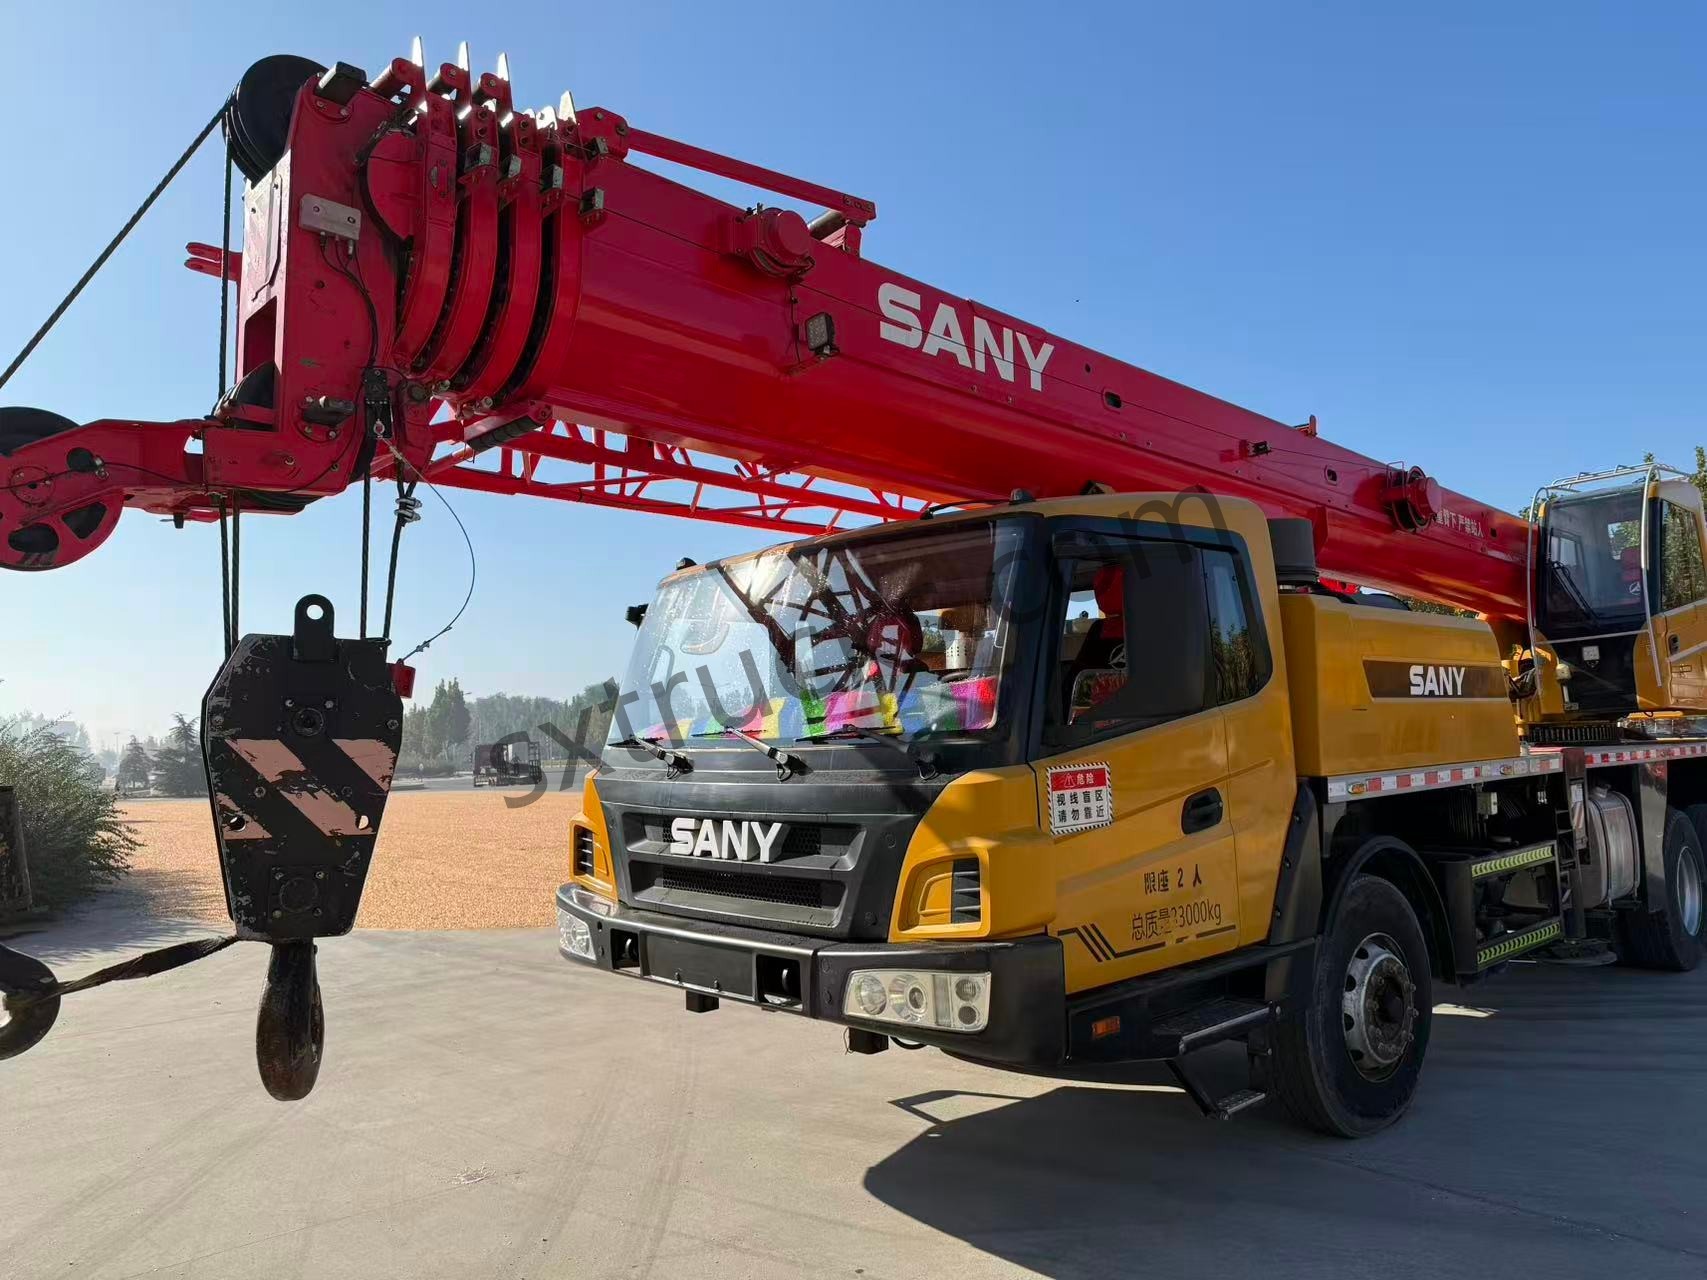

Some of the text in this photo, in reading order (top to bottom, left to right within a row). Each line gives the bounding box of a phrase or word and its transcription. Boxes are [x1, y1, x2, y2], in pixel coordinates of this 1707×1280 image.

[878, 282, 1055, 392] SANY
[1409, 664, 1466, 696] SANY
[1076, 772, 1095, 785] 危险
[1056, 789, 1104, 807] 视线盲区
[1057, 804, 1105, 823] 请勿靠近
[670, 817, 783, 863] SANY
